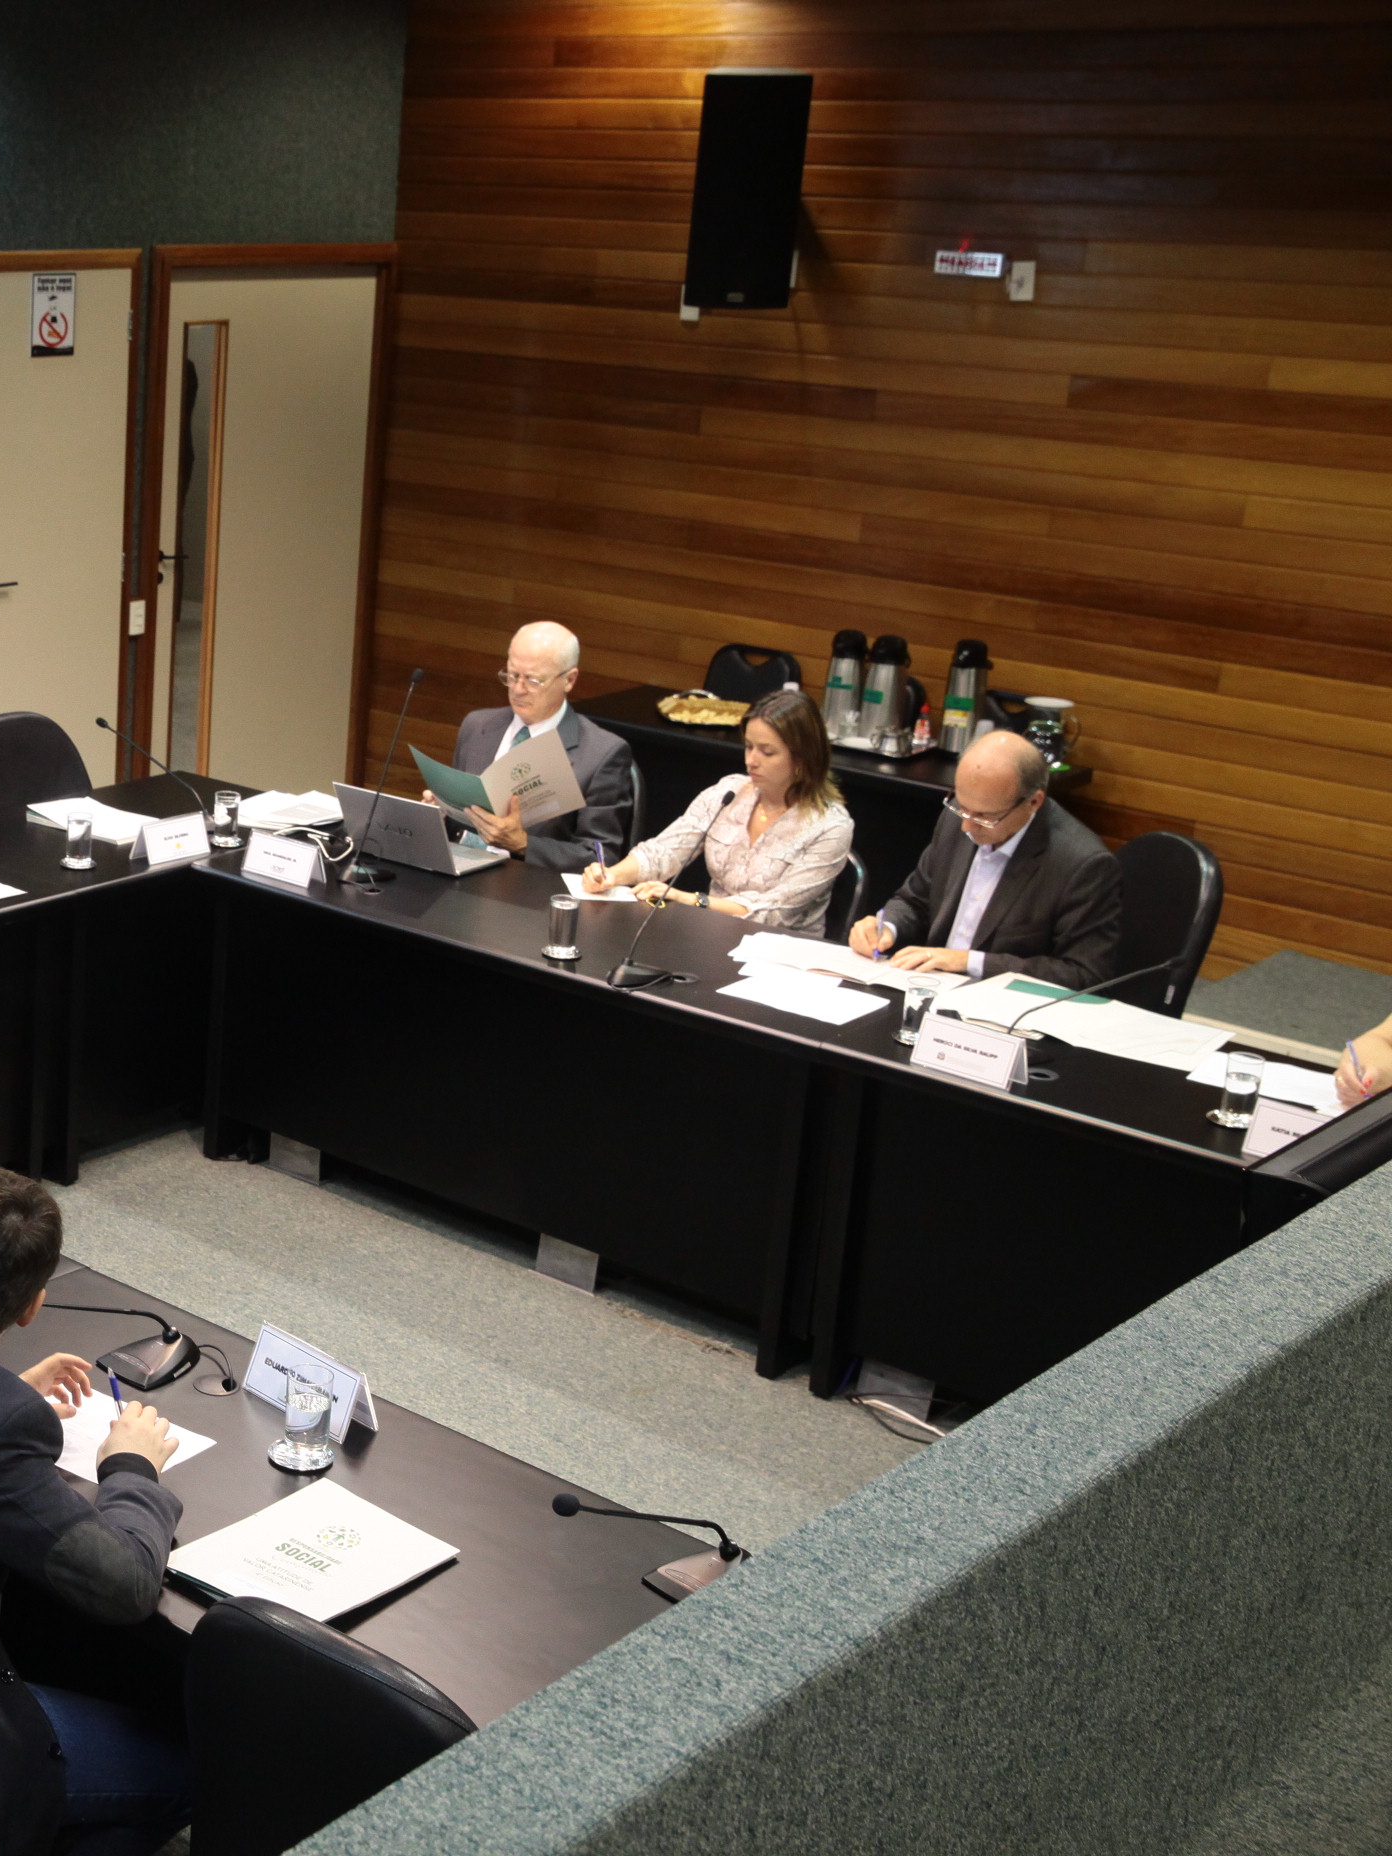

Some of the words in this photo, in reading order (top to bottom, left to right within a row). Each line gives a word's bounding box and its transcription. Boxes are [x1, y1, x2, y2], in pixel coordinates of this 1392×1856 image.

[377, 822, 413, 838] VAIO
[264, 1357, 296, 1378] EDUARDO
[275, 1542, 332, 1572] SOCIAL
